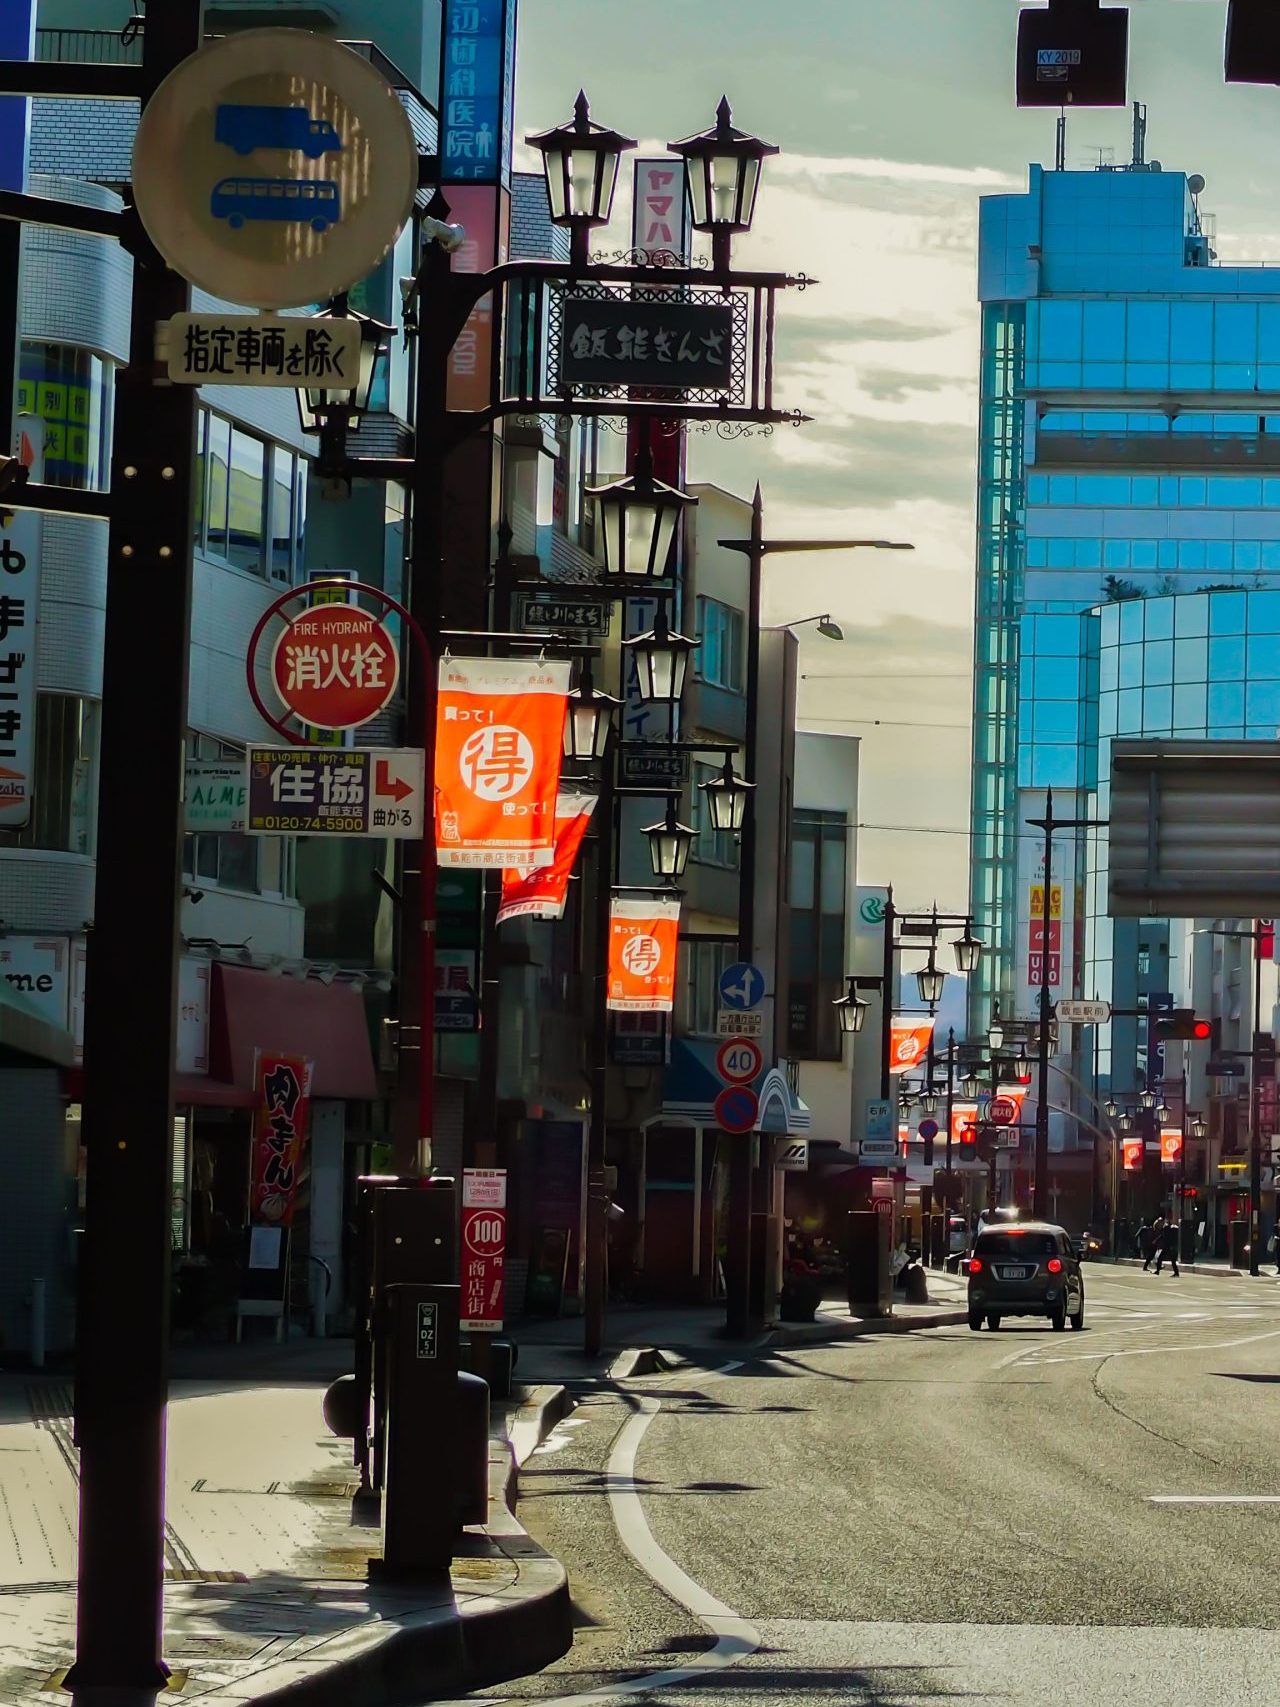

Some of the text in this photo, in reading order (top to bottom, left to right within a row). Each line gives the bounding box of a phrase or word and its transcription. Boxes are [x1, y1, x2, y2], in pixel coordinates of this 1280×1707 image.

[448, 0, 479, 159] 辺歯科医院
[453, 165, 486, 178] 4F
[646, 169, 674, 243] ヤマハ
[184, 325, 346, 379] 指定車両を除く
[569, 321, 729, 366] 飯能ぎんざ
[294, 619, 374, 637] FIRE HYDRANT
[286, 642, 388, 690] 消火栓
[464, 731, 529, 793] 得
[270, 764, 364, 804] 住協
[265, 816, 364, 831] 0120-74-5900
[373, 808, 412, 827] 曲がる
[1031, 890, 1060, 903] AC
[624, 938, 658, 972] 得
[727, 1050, 752, 1071] 40
[264, 1064, 301, 1191] 肉まん
[472, 1219, 502, 1244] 100
[493, 1256, 503, 1267] 円
[467, 1259, 486, 1315] 商店街
[420, 1329, 434, 1340] DZ
